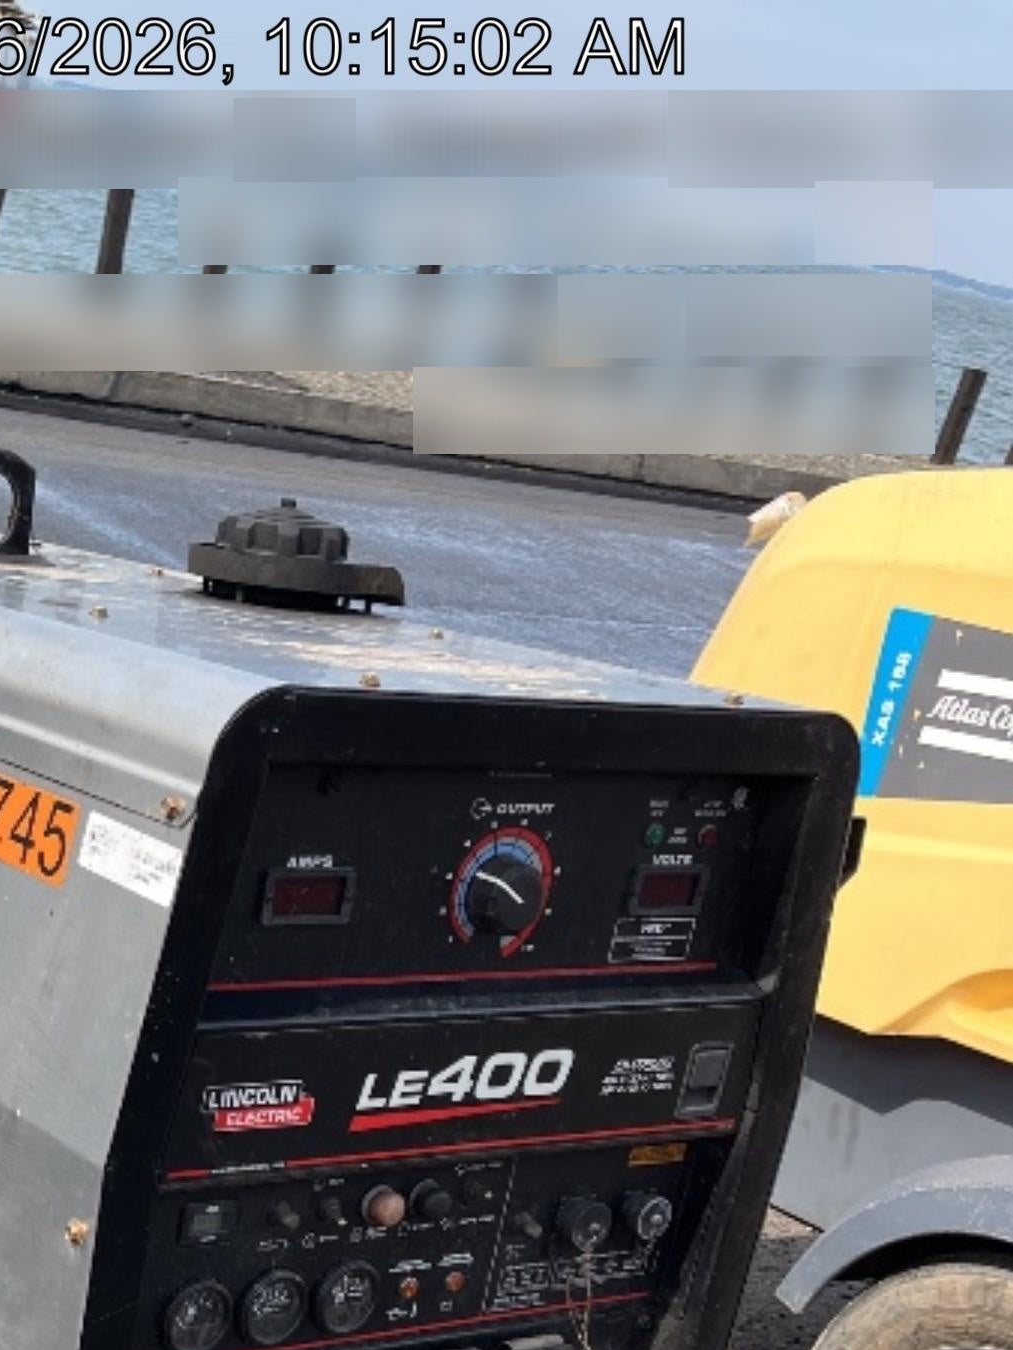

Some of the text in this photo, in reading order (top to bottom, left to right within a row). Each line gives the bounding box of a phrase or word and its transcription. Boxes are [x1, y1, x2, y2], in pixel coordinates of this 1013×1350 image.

[925, 695, 990, 727] Atlas
[496, 802, 555, 815] OUTPUT
[355, 1049, 575, 1112] LE400
[207, 1083, 299, 1109] LINCOLN
[225, 1106, 304, 1127] ELECTRIC
